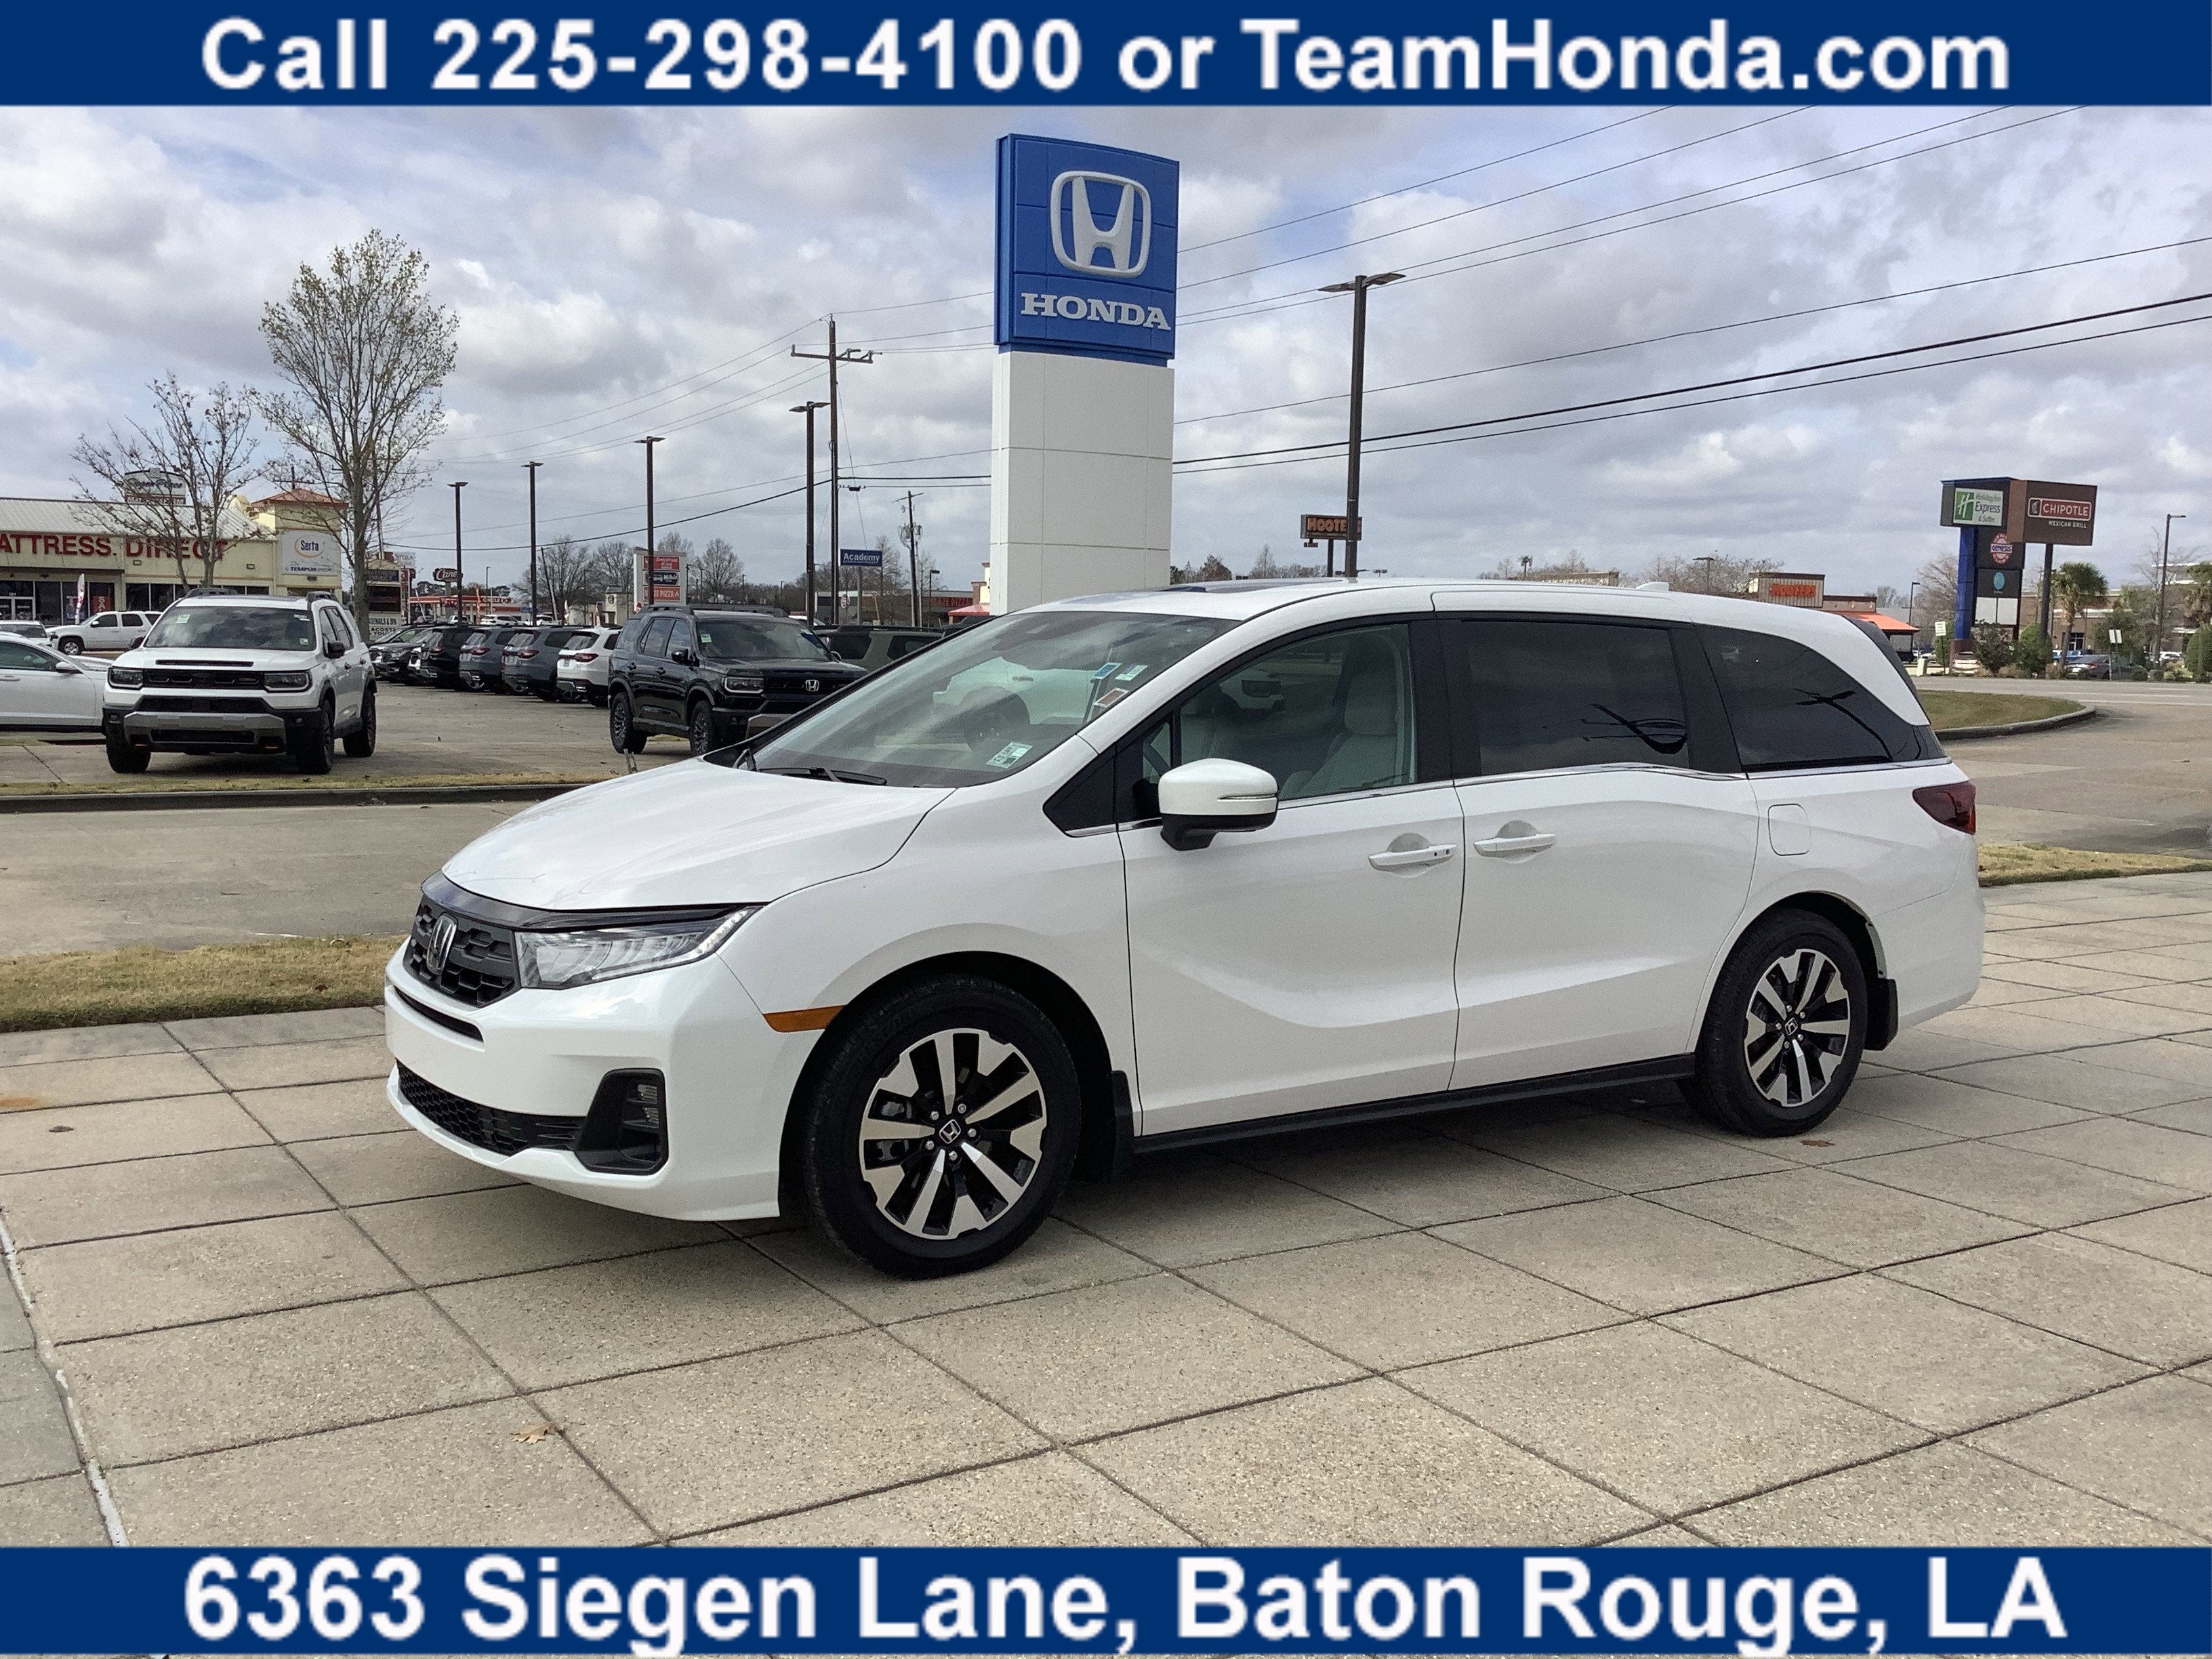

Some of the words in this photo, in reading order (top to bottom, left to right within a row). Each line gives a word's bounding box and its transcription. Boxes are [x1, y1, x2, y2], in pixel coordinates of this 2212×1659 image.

[1021, 293, 1172, 331] HONDA
[1975, 501, 2001, 514] Express
[2043, 504, 2089, 516] CHIPOTLE
[1307, 517, 1361, 533] HOOTES
[300, 539, 319, 552] Serta
[843, 552, 880, 563] Academy
